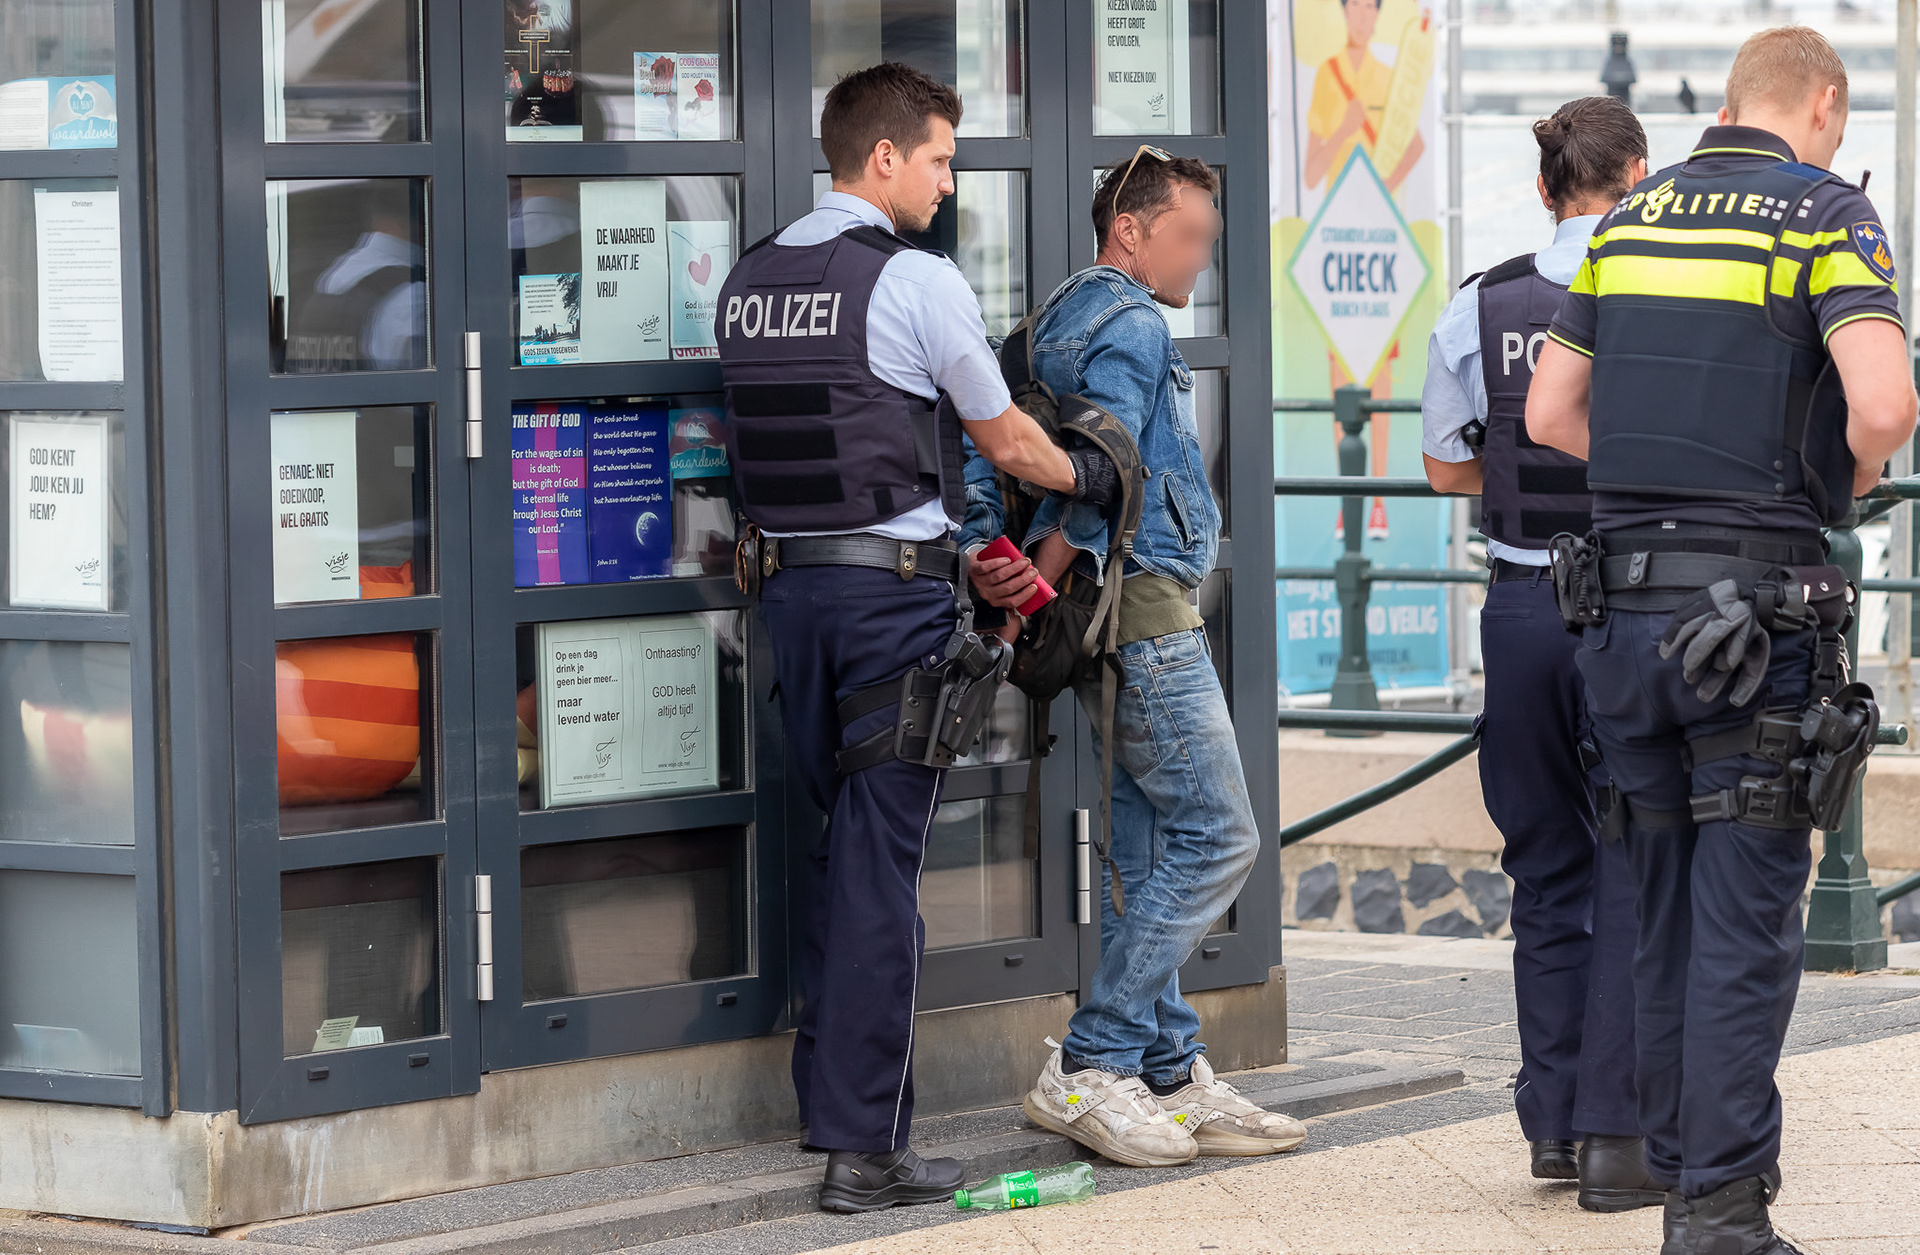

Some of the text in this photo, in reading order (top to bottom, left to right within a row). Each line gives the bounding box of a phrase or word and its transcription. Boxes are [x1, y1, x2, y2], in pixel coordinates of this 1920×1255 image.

[1108, 0, 1156, 11] KIEZEN VOOR GOD
[1108, 18, 1145, 29] HEEFT GROTE
[1108, 36, 1140, 47] GEVOLGEN,
[640, 56, 647, 68] Je
[695, 58, 718, 66] GENADE
[1109, 72, 1122, 82] NIET
[1124, 72, 1144, 82] KIEZEN
[52, 120, 116, 140] waardevol
[1628, 178, 1763, 223] POLITIE
[596, 227, 655, 245] DE WAARHEID
[598, 254, 639, 271] MAAKT JE
[1323, 252, 1396, 293] CHECK
[597, 281, 617, 297] VRIJ!
[685, 301, 697, 309] God
[704, 300, 717, 309] liefd
[725, 292, 842, 338] POLIZEI
[1502, 332, 1547, 375] PO
[512, 413, 580, 428] THE GIFT OF GOD
[30, 448, 75, 466] GOD KENT
[512, 448, 583, 460] For the wages of sin
[604, 448, 616, 456] only
[617, 447, 642, 456] begotten
[671, 449, 728, 469] waardevol
[279, 463, 334, 480] GENADE: NIET
[530, 463, 560, 474] is death;
[30, 476, 83, 494] JOU! KEN JIJ
[512, 477, 578, 490] but the gift of God
[615, 479, 634, 487] should
[280, 488, 325, 504] GOEDKOOP,
[523, 492, 569, 504] is eternal life
[620, 495, 650, 503] everlasting
[30, 503, 56, 520] HEM?
[513, 508, 582, 521] hrough Jesus Christ
[280, 511, 328, 528] WEL GRATIS
[325, 552, 349, 567] visje
[1288, 608, 1318, 640] HET
[556, 651, 566, 662] Op
[584, 650, 597, 659] dag
[646, 644, 701, 659] Onthaasting?
[556, 663, 584, 674] drink je
[557, 678, 575, 688] geen
[577, 676, 592, 684] bier
[652, 684, 696, 698] GOD heeft
[558, 698, 582, 708] maar
[658, 703, 694, 718] altijd tijd!
[558, 711, 620, 725] levend water
